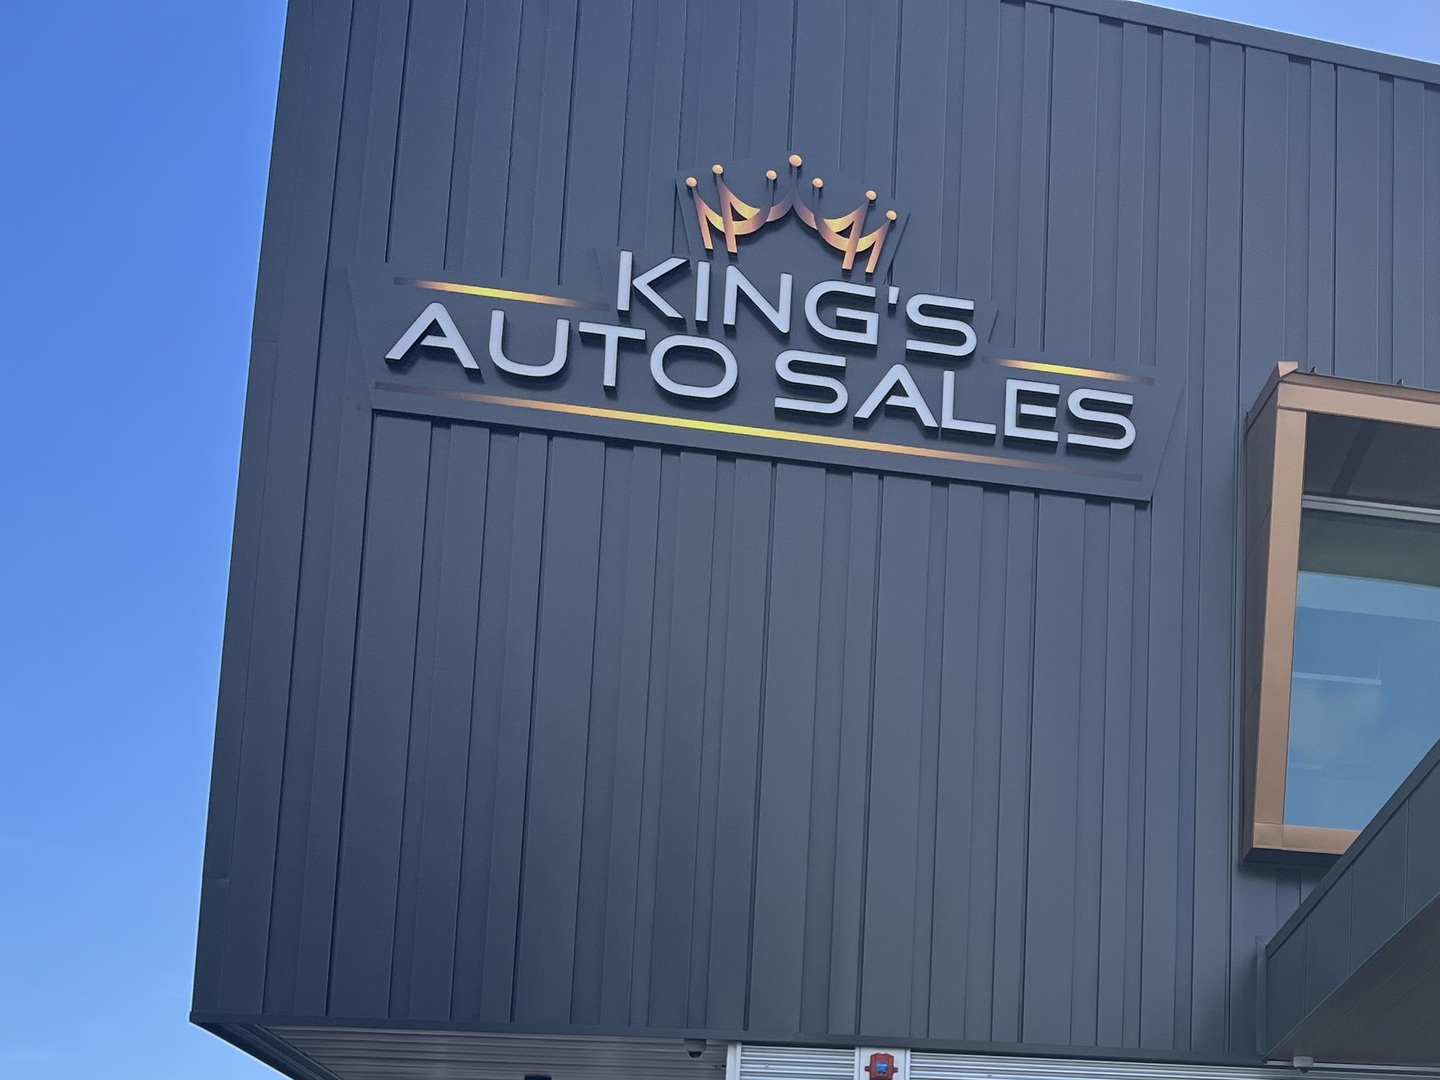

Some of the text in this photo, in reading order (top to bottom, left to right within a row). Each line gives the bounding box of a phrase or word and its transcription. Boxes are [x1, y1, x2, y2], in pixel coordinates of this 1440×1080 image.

[617, 249, 978, 357] KING'S
[384, 301, 1138, 452] AUTO SALES
